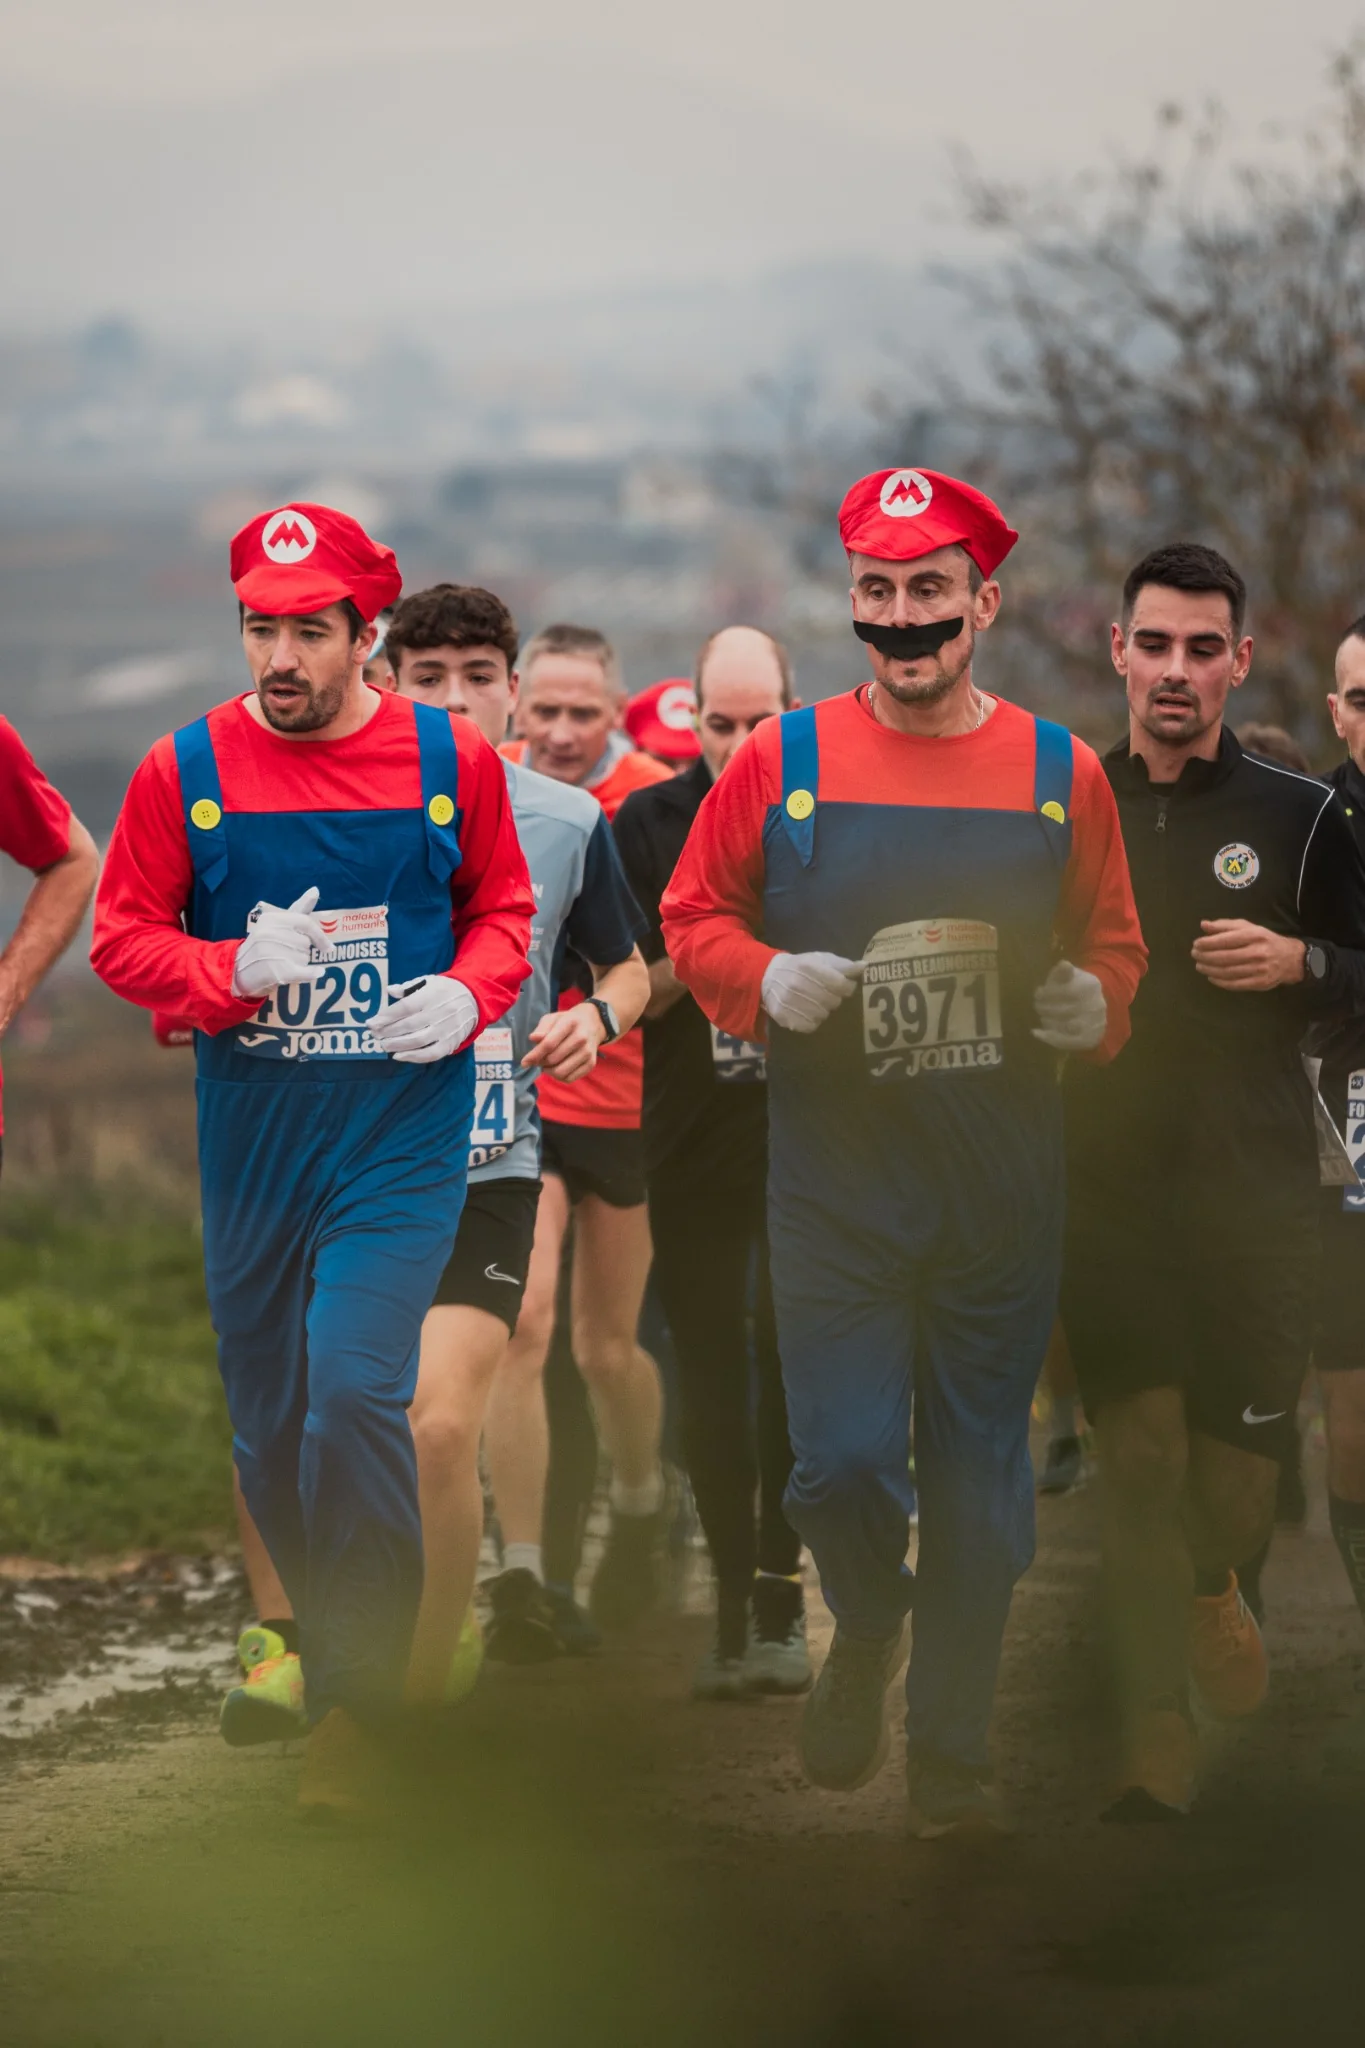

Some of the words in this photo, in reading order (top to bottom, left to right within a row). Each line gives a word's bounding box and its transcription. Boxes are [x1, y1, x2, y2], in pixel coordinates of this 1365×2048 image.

[885, 478, 926, 506] M
[267, 519, 310, 549] M
[864, 960, 911, 983] FOULÉES
[914, 953, 997, 977] BEAUNOISES
[257, 962, 382, 1027] 029
[869, 974, 988, 1049] 3971
